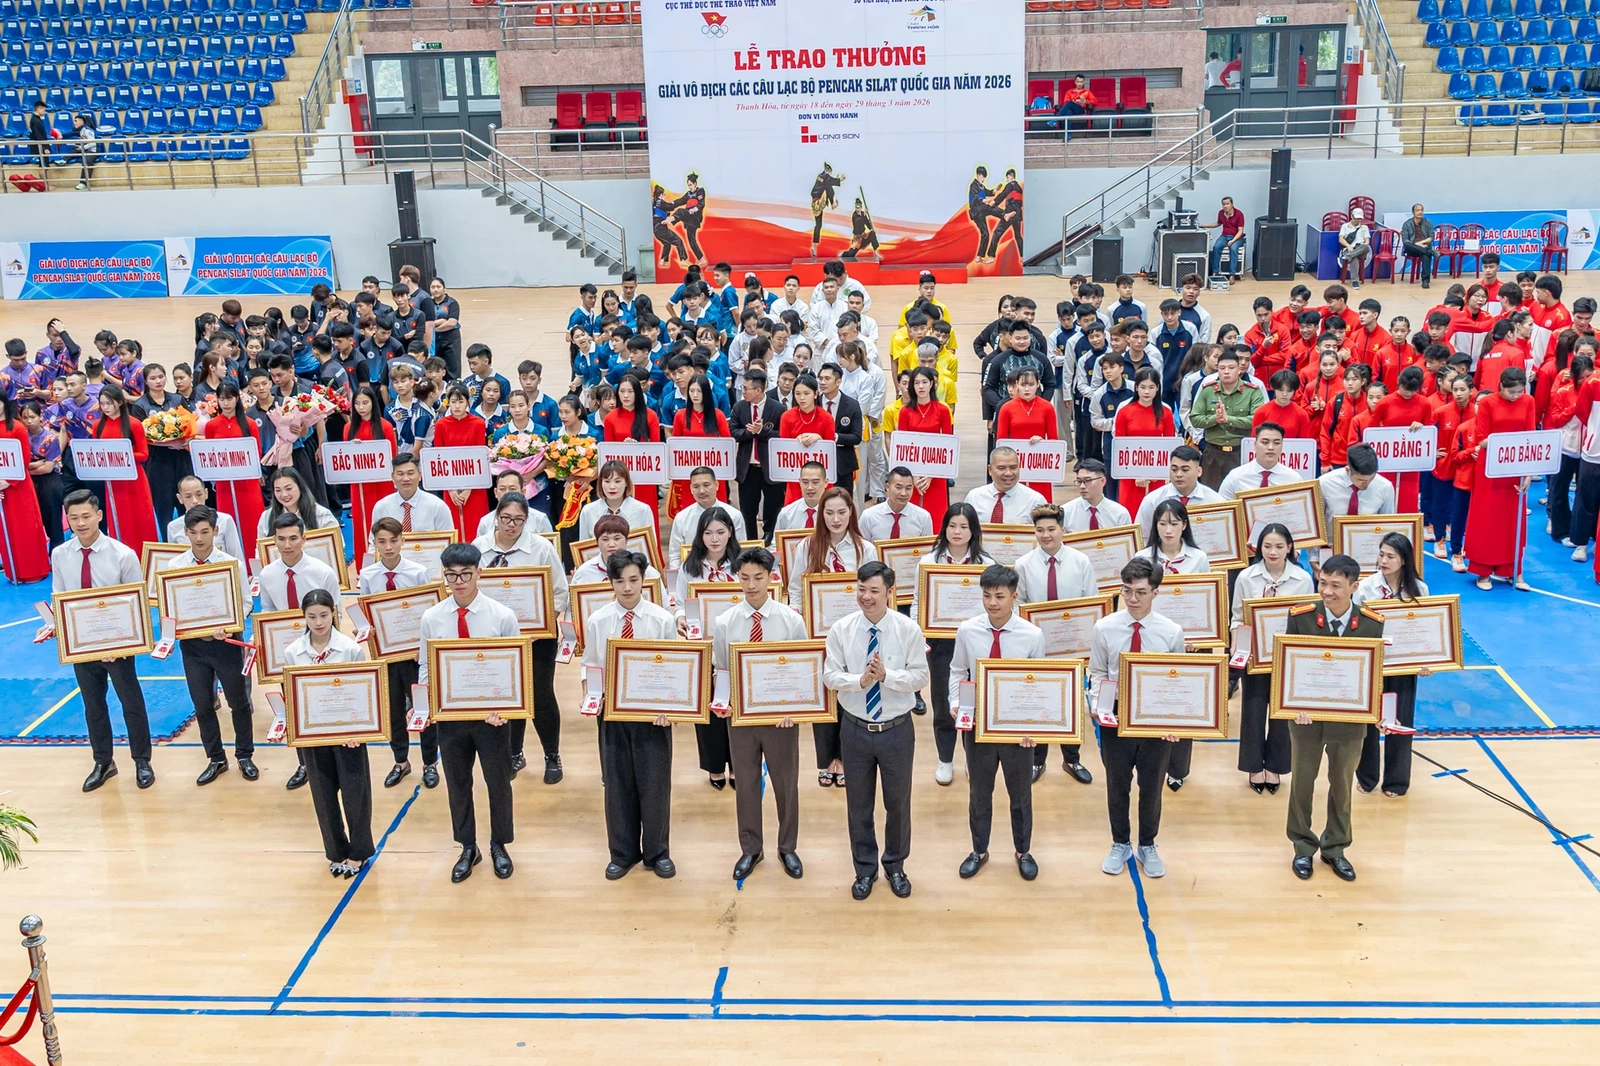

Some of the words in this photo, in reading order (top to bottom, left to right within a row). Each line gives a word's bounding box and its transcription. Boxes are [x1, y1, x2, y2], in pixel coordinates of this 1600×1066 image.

[734, 43, 760, 70] LỄ
[767, 49, 826, 69] TRAO
[833, 41, 926, 67] THƯỞNG
[659, 80, 680, 98] GIẢI
[684, 81, 698, 97] VÔ
[701, 82, 726, 99] ĐỊCH
[730, 80, 750, 96] CÁC
[753, 79, 774, 95] CÂU
[778, 80, 798, 97] LẠC
[801, 78, 815, 96] BỘ
[819, 78, 863, 94] PENCAK
[866, 78, 898, 92] SILAT
[900, 72, 929, 93] QUỐC
[932, 76, 950, 90] GIA
[954, 73, 981, 90] NĂM
[985, 74, 1011, 89] 2026
[761, 102, 778, 111] Hóa,
[790, 102, 809, 111] ngày
[820, 100, 834, 108] đến
[835, 101, 852, 109] ngày
[866, 100, 886, 108] tháng
[1503, 244, 1516, 253] GIA
[33, 274, 62, 282] PENCAK
[65, 273, 86, 282] SILAT
[109, 273, 120, 282] GIA
[143, 272, 161, 281] 2026
[199, 269, 227, 278] PENCAK
[230, 268, 251, 278] SILAT
[274, 269, 286, 277] GIA
[309, 268, 326, 277] 2026
[77, 452, 87, 467] TP.
[86, 446, 96, 467] HỒ
[96, 448, 107, 467] CHÍ
[107, 452, 125, 467] MINH
[125, 452, 131, 467] 2
[896, 442, 919, 462] TUYÊN
[922, 446, 947, 464] QUANG
[950, 449, 954, 464] 1
[1393, 434, 1422, 458] BẰNG
[1426, 440, 1430, 456] 1
[1498, 446, 1515, 463] CAO
[1518, 439, 1542, 462] BẰNG
[1546, 444, 1551, 460] 2
[11, 452, 16, 467] 1
[198, 452, 209, 468] TP.
[208, 446, 217, 468] HỒ
[218, 448, 229, 467] CHÍ
[229, 451, 246, 467] MINH
[247, 451, 251, 466] 1
[332, 448, 350, 471] BẮC
[353, 454, 377, 470] NINH
[378, 452, 385, 468] 2
[430, 454, 449, 477] BẮC
[452, 459, 475, 476] NINH
[477, 459, 482, 475] 1
[636, 452, 653, 471] HÓA
[655, 456, 661, 471] 2
[674, 450, 701, 467] THANH
[704, 447, 722, 467] HÓA
[724, 451, 729, 467] 1
[1028, 453, 1053, 470] QUANG
[1054, 454, 1060, 470] 2
[1119, 447, 1130, 470] BỘ
[1132, 447, 1154, 466] CÔNG
[1157, 450, 1168, 466] AN
[1289, 453, 1300, 469] AN
[1303, 453, 1309, 470] 2
